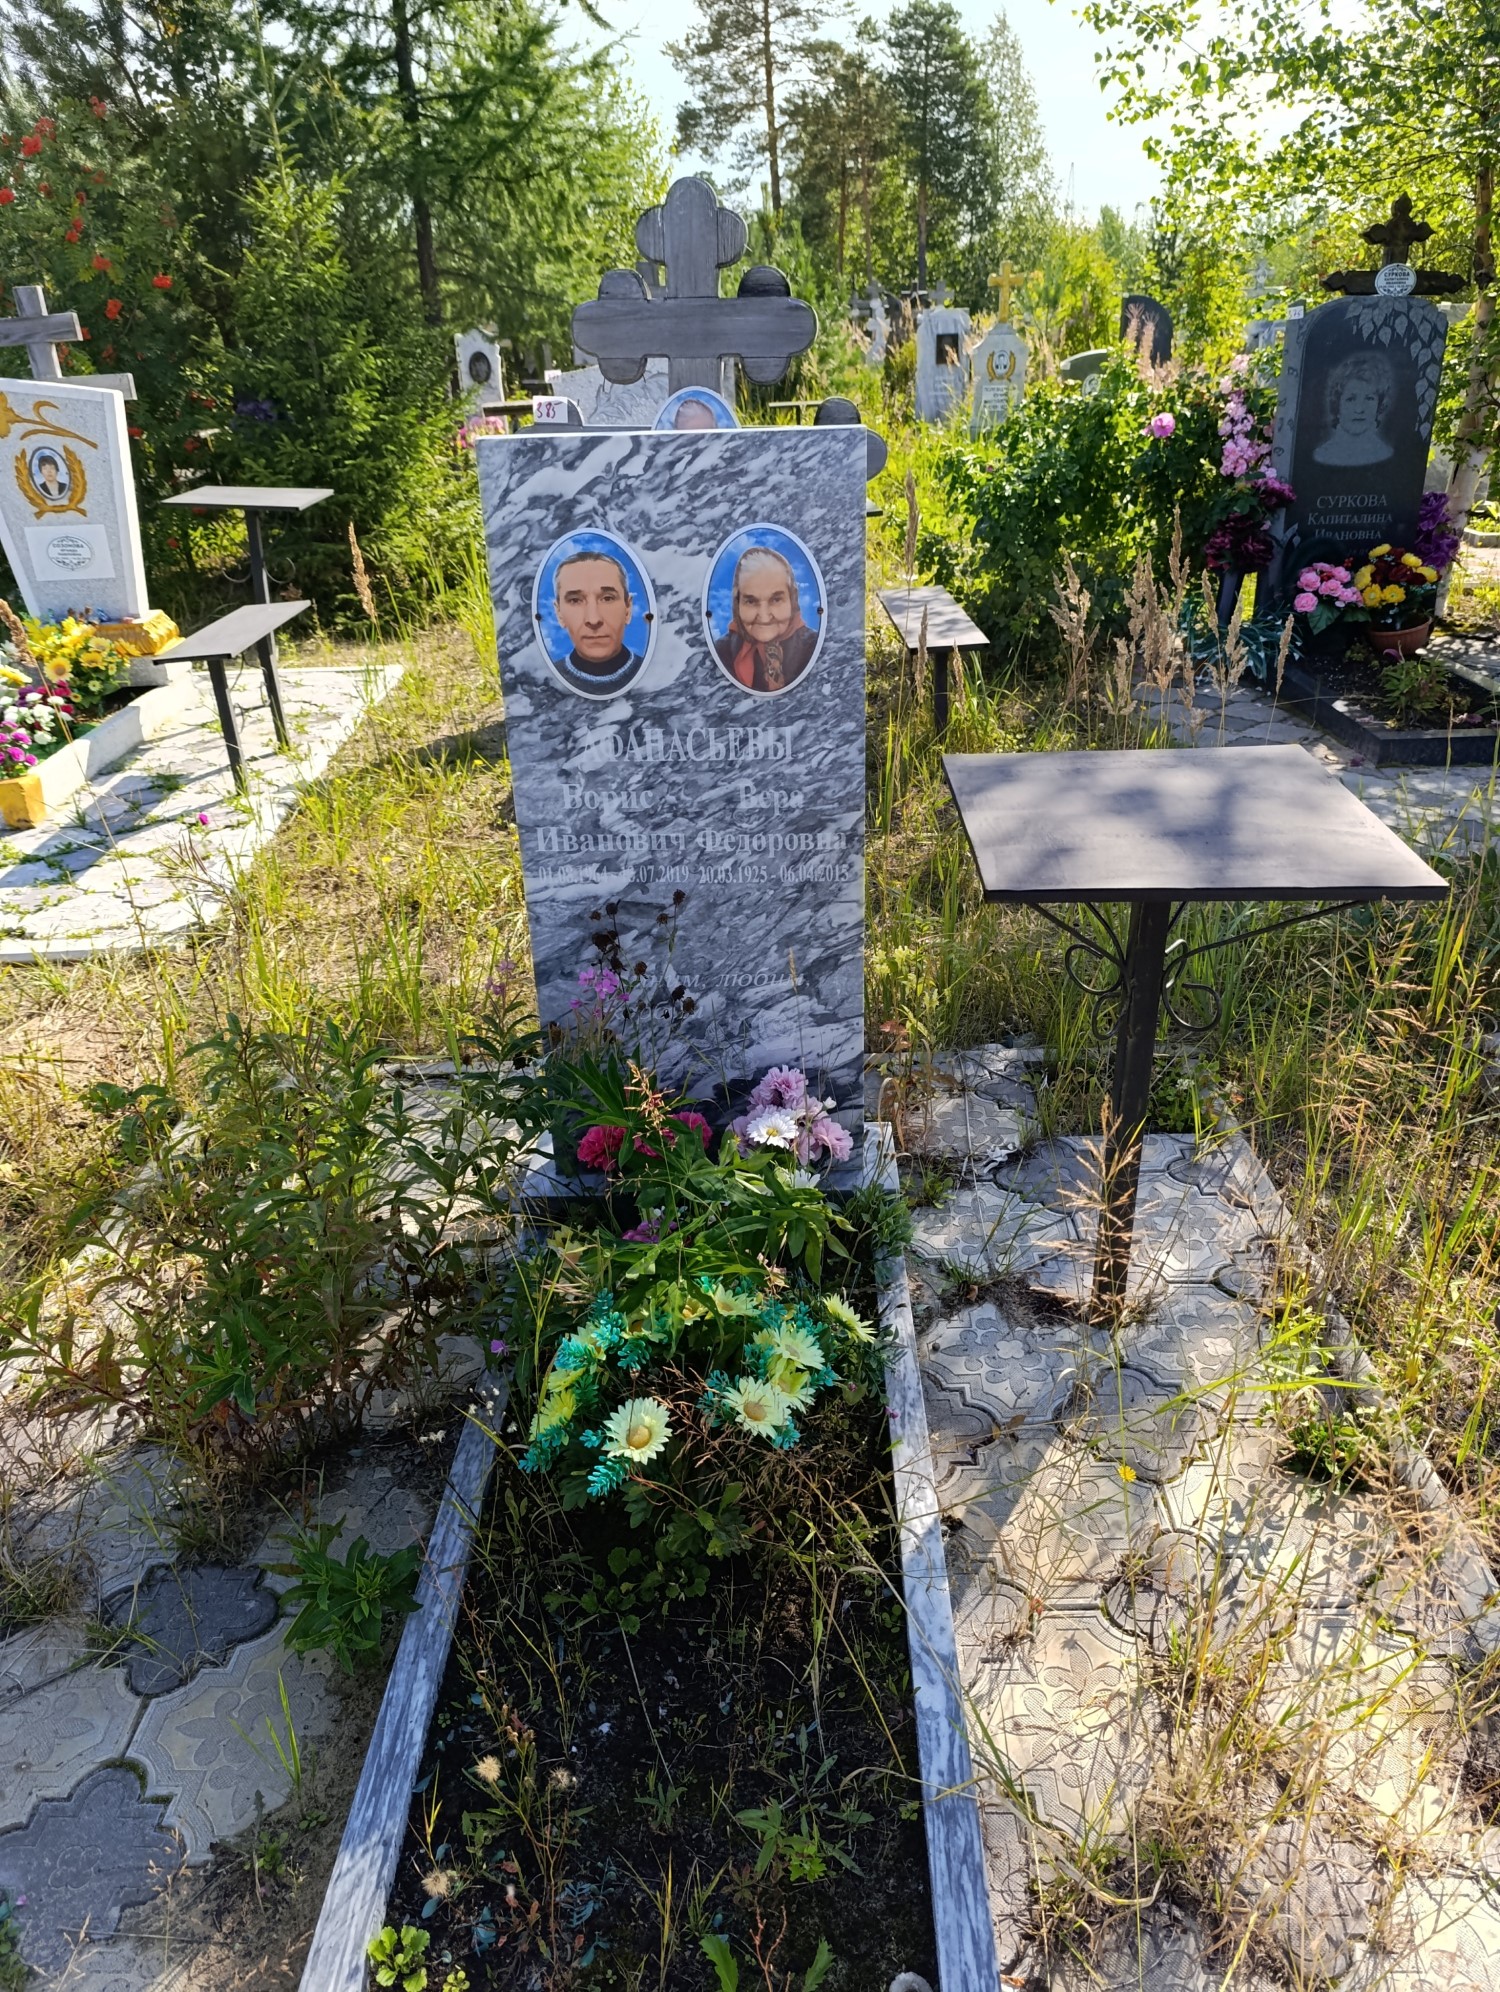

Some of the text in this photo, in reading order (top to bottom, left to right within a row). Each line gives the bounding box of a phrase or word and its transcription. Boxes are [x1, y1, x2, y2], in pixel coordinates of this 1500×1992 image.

[536, 401, 564, 419] 385
[1316, 494, 1388, 509] СУРКОВА
[583, 726, 795, 762] АФАНАСЬЕВЫ
[561, 783, 653, 816] Борис
[737, 782, 804, 815] Вера
[535, 826, 688, 852] Иванович
[695, 827, 847, 858] Федоровна
[699, 865, 768, 884] 20.03.1925
[779, 864, 849, 882] 06.04.2015
